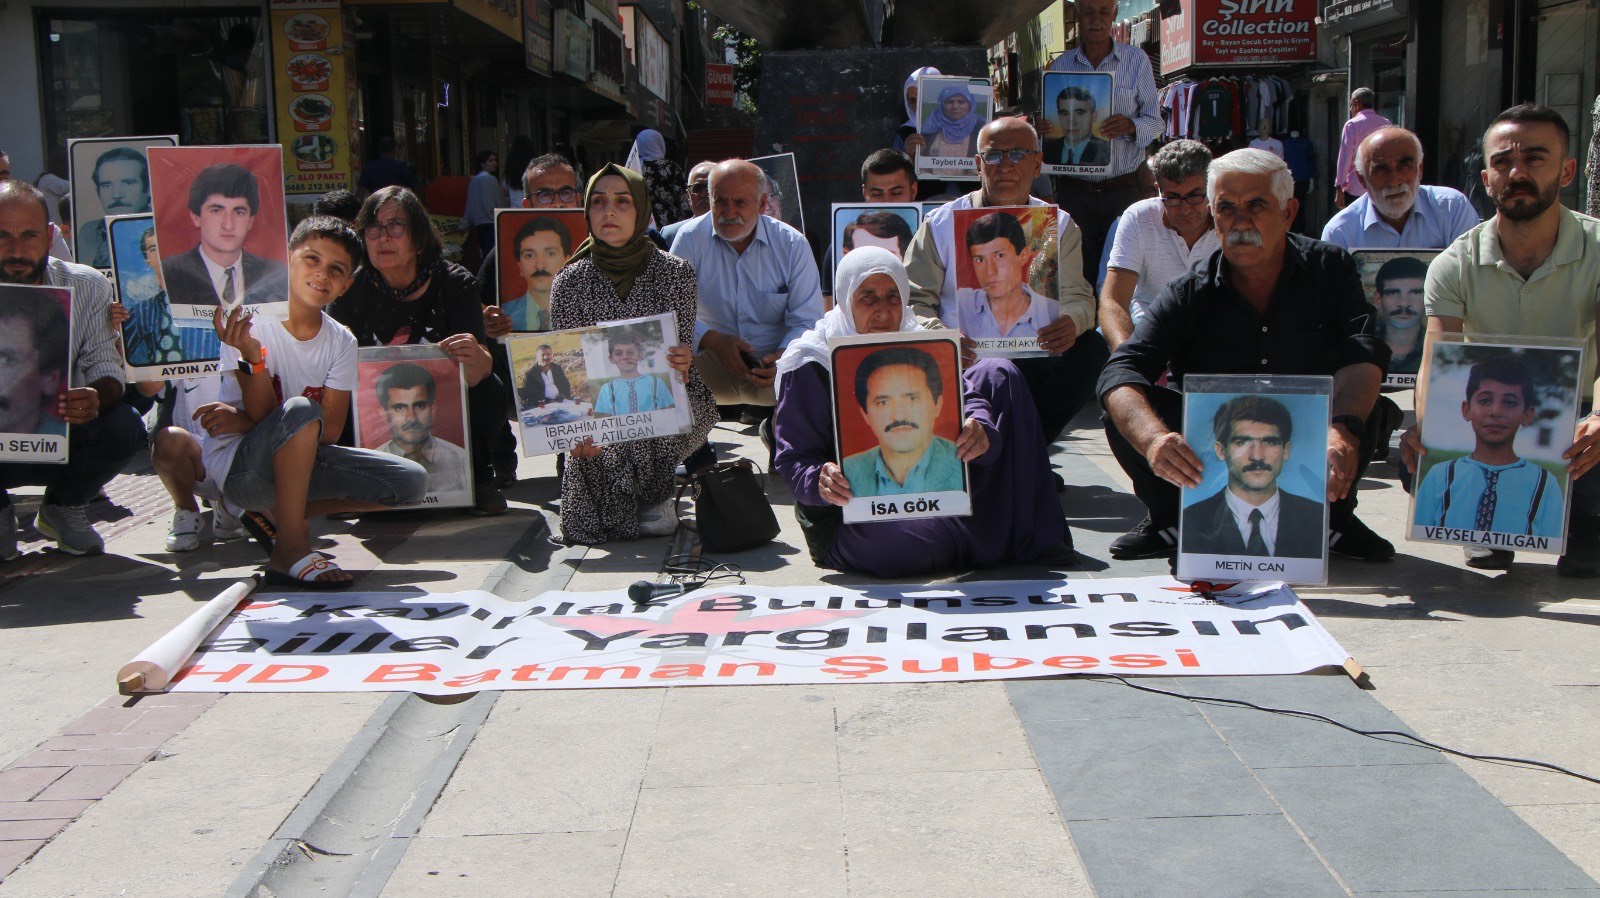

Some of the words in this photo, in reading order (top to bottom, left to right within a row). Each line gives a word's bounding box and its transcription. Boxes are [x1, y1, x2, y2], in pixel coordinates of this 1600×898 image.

[1202, 17, 1309, 36] Collection
[1291, 37, 1310, 45] Giyim
[1213, 99, 1217, 116] 1
[932, 158, 956, 166] Taybet
[192, 306, 219, 317] İhsa
[997, 339, 1016, 348] ZEKİ
[162, 365, 199, 376] AYDIN
[545, 420, 597, 437] İBRAHİM
[600, 412, 652, 430] ATILGAN
[602, 426, 655, 443] ATILGAN
[9, 438, 57, 453] SEVİM
[871, 501, 899, 515] İSA
[903, 497, 941, 513] GÖK
[1425, 526, 1477, 543] VEYSEL
[1481, 532, 1548, 550] ATILGAN
[1215, 559, 1252, 571] METİN
[1258, 562, 1285, 572] CAN
[296, 602, 669, 630] Kayıplar
[698, 591, 1139, 612] Bulunsun
[563, 612, 1310, 652] Yargılansın
[362, 662, 777, 688] Batman
[820, 648, 1200, 680] Şubesi
